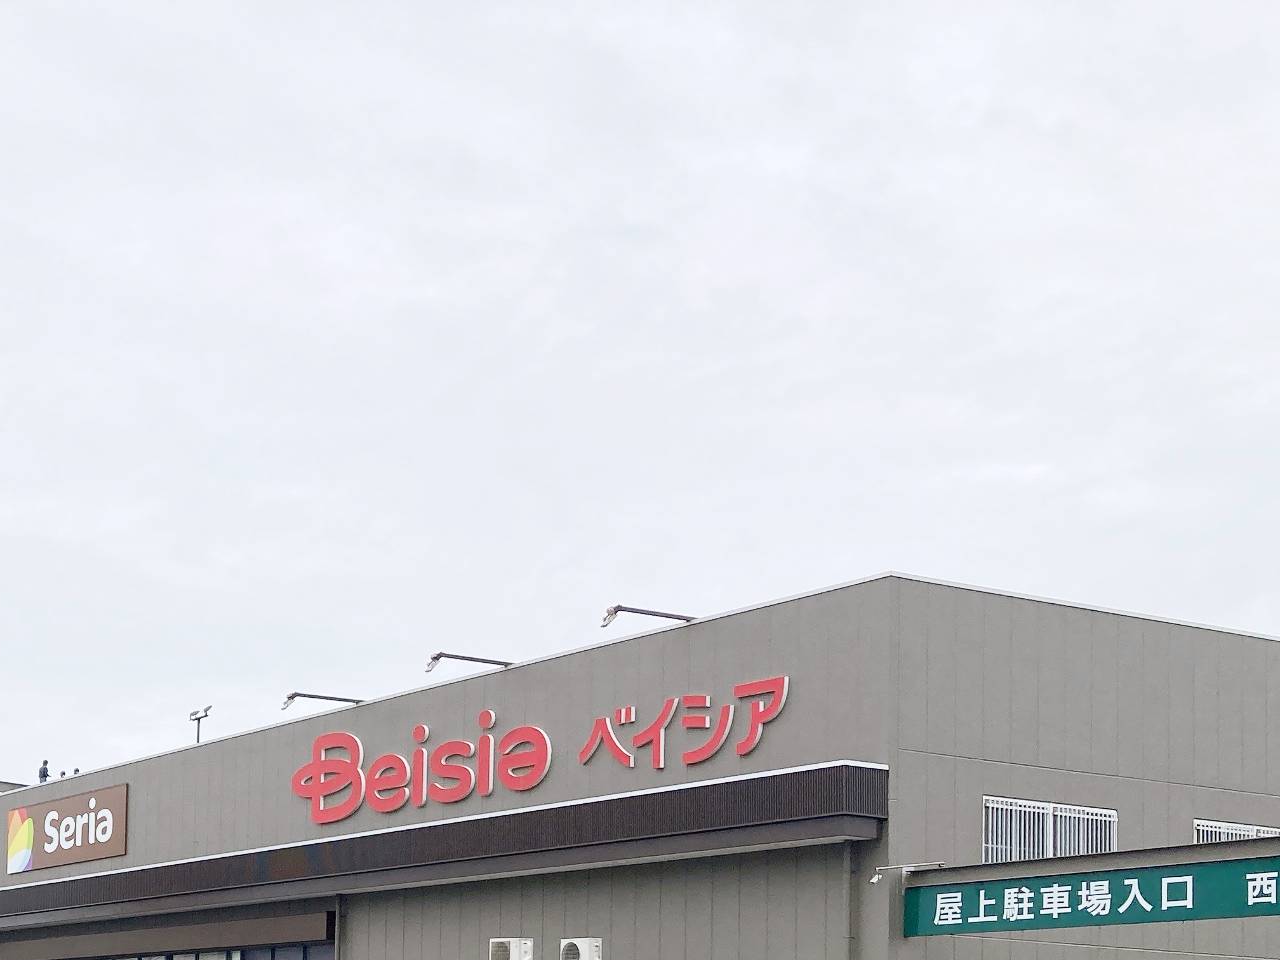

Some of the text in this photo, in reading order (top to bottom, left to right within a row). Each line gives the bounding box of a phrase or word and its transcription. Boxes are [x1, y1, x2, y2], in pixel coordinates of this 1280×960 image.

[291, 675, 790, 825] Beisia ベイシア
[44, 797, 114, 854] Seria
[933, 871, 1279, 927] 屋上駐車場入口 西
